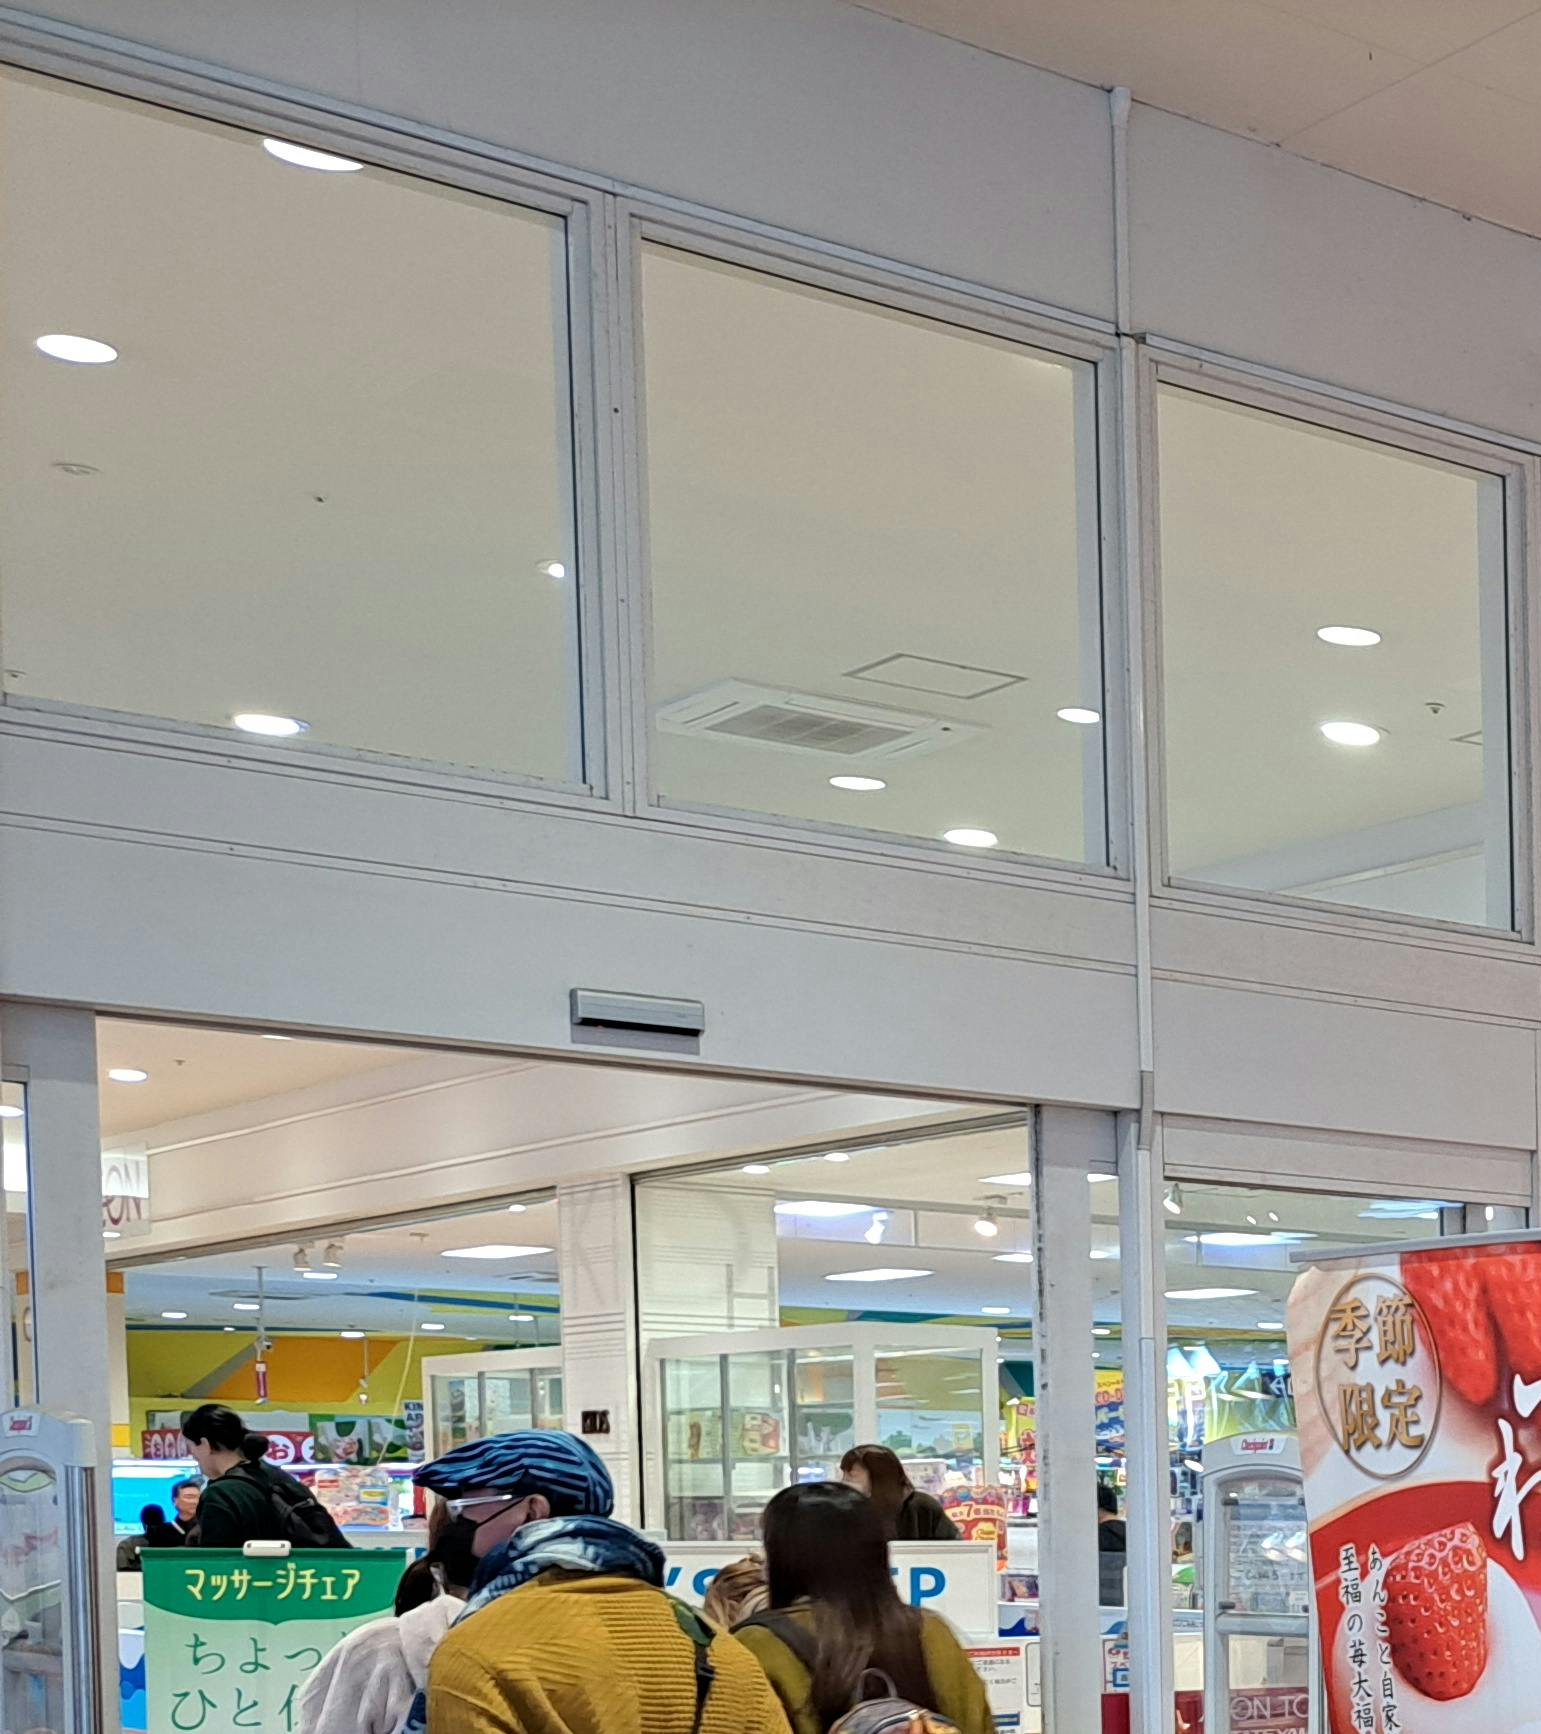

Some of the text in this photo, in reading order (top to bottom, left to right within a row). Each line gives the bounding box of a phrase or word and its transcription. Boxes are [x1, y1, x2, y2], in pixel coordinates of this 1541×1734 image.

[1329, 1294, 1416, 1369] 季節
[1339, 1381, 1426, 1451] 限定
[184, 1562, 363, 1602] マッサージチェア
[184, 1632, 326, 1675] ちょっ
